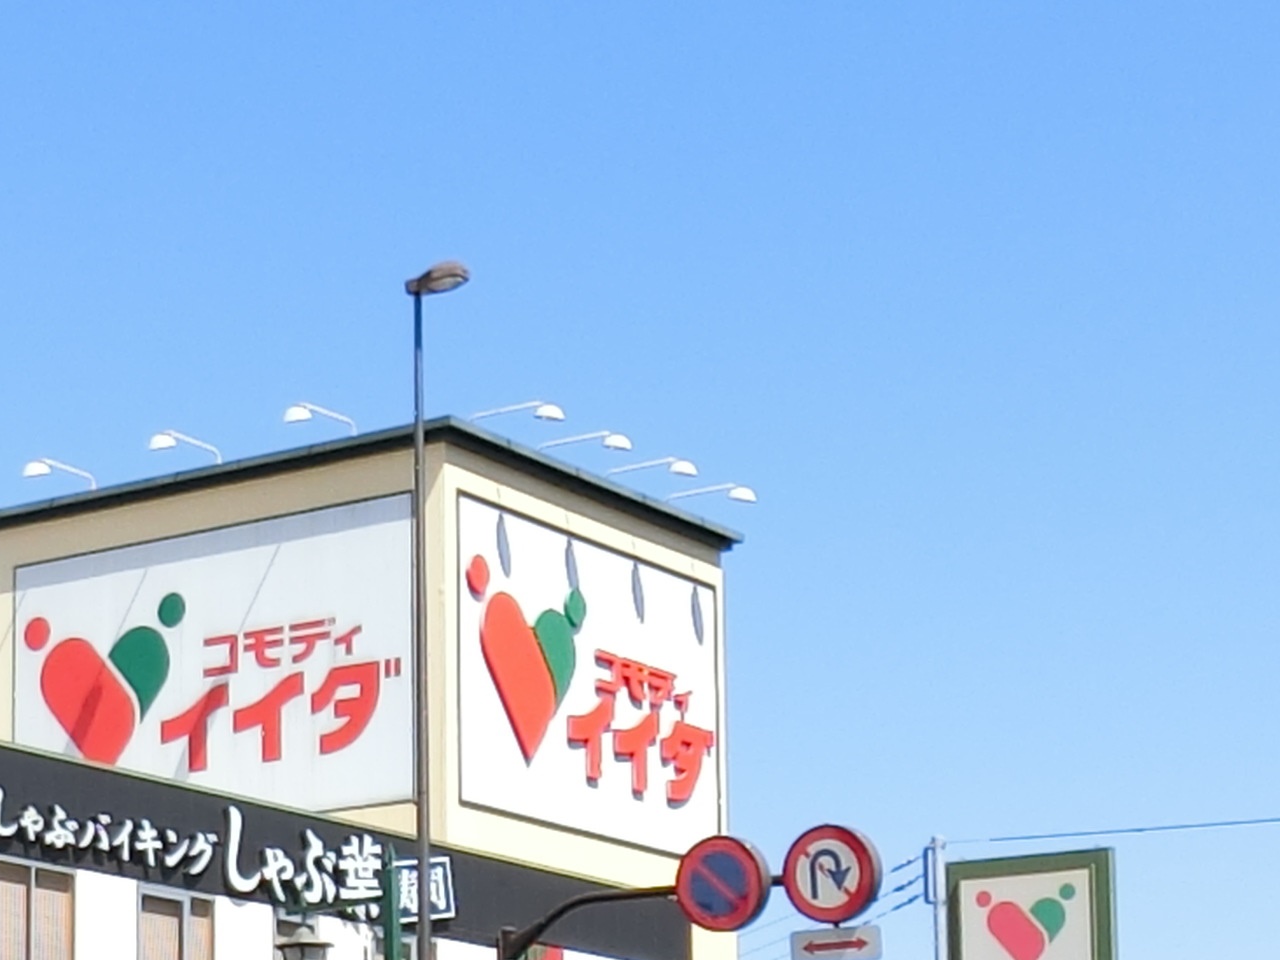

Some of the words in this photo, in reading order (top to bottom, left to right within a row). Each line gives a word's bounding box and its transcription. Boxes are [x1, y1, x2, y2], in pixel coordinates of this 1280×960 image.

[203, 617, 362, 678] コモディ
[594, 649, 692, 714] コモディ
[161, 657, 401, 773] イイダ
[567, 695, 714, 806] イイダ
[227, 805, 384, 921] しゃぶ葉
